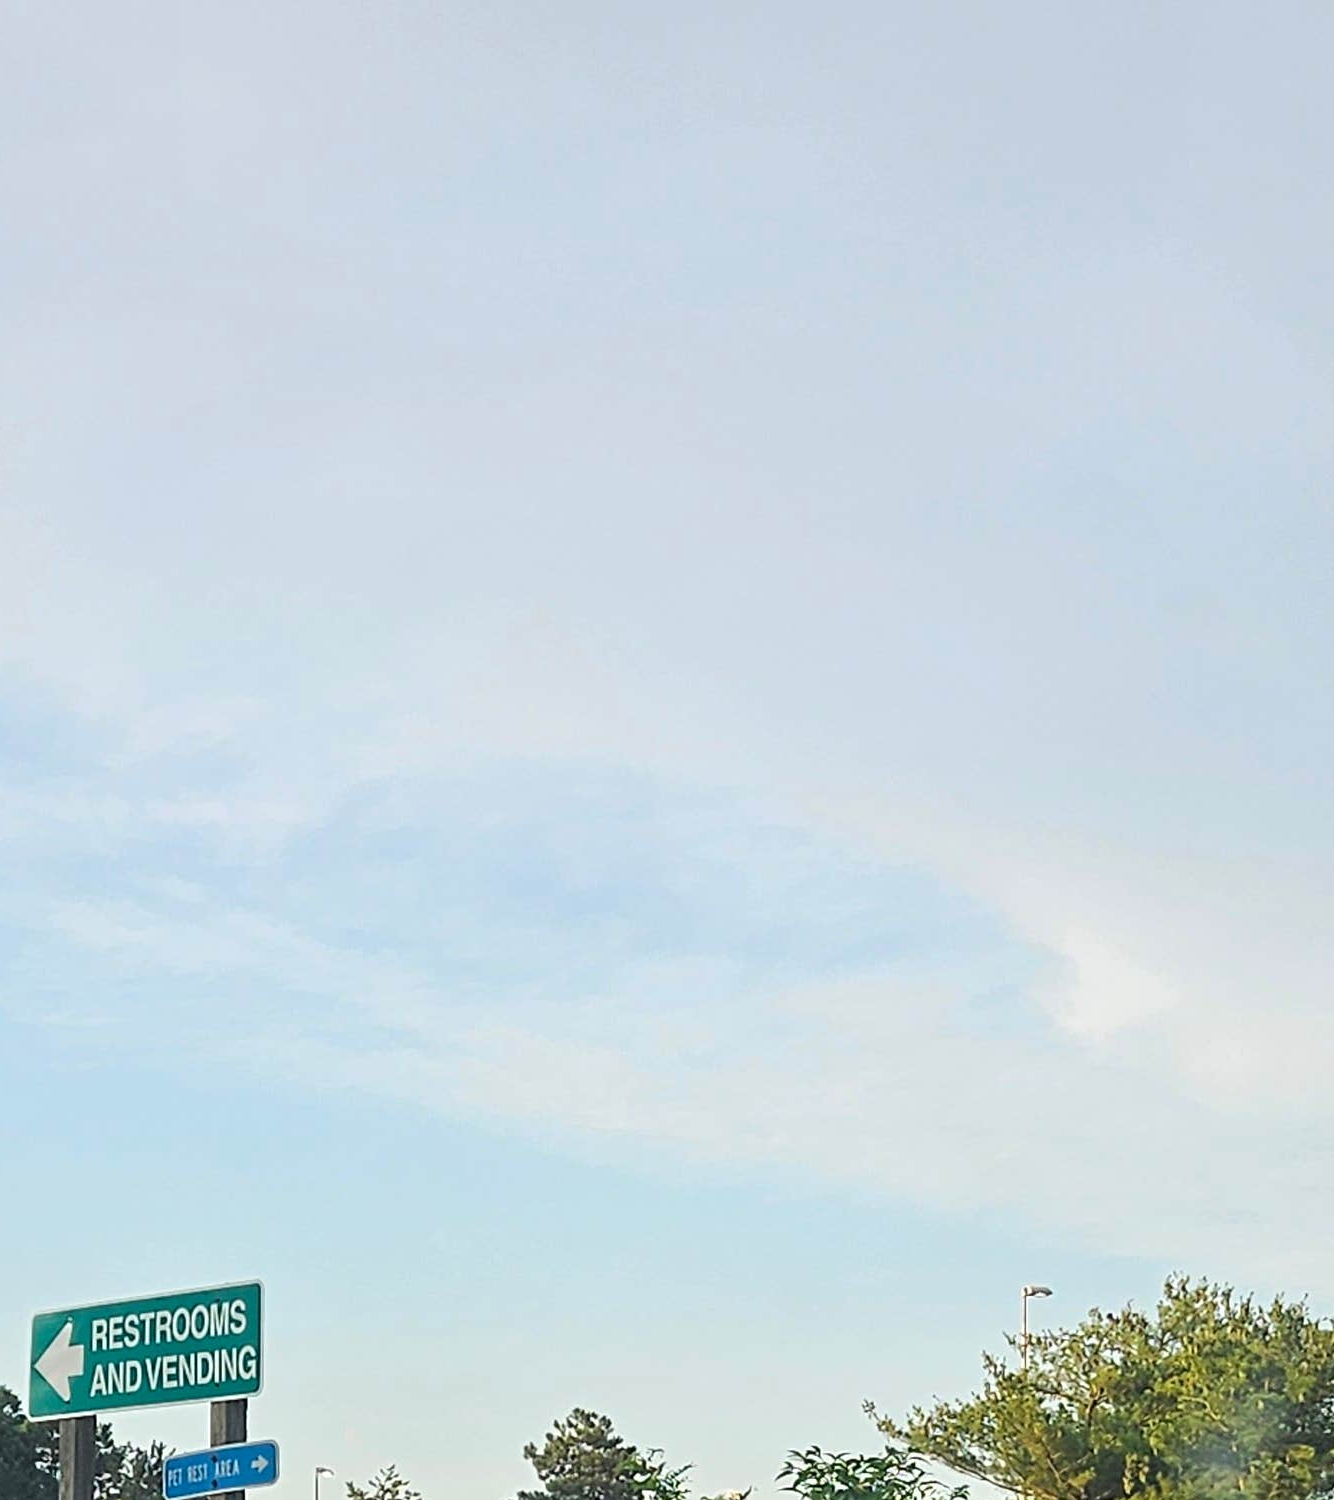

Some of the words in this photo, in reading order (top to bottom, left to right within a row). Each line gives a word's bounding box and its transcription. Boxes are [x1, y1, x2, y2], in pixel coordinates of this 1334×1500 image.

[92, 1299, 246, 1351] RESTROOMS
[90, 1360, 142, 1397] AND
[145, 1345, 256, 1390] VENDING
[168, 1468, 182, 1487] PET
[187, 1463, 208, 1483] REST
[215, 1459, 240, 1477] AREA
